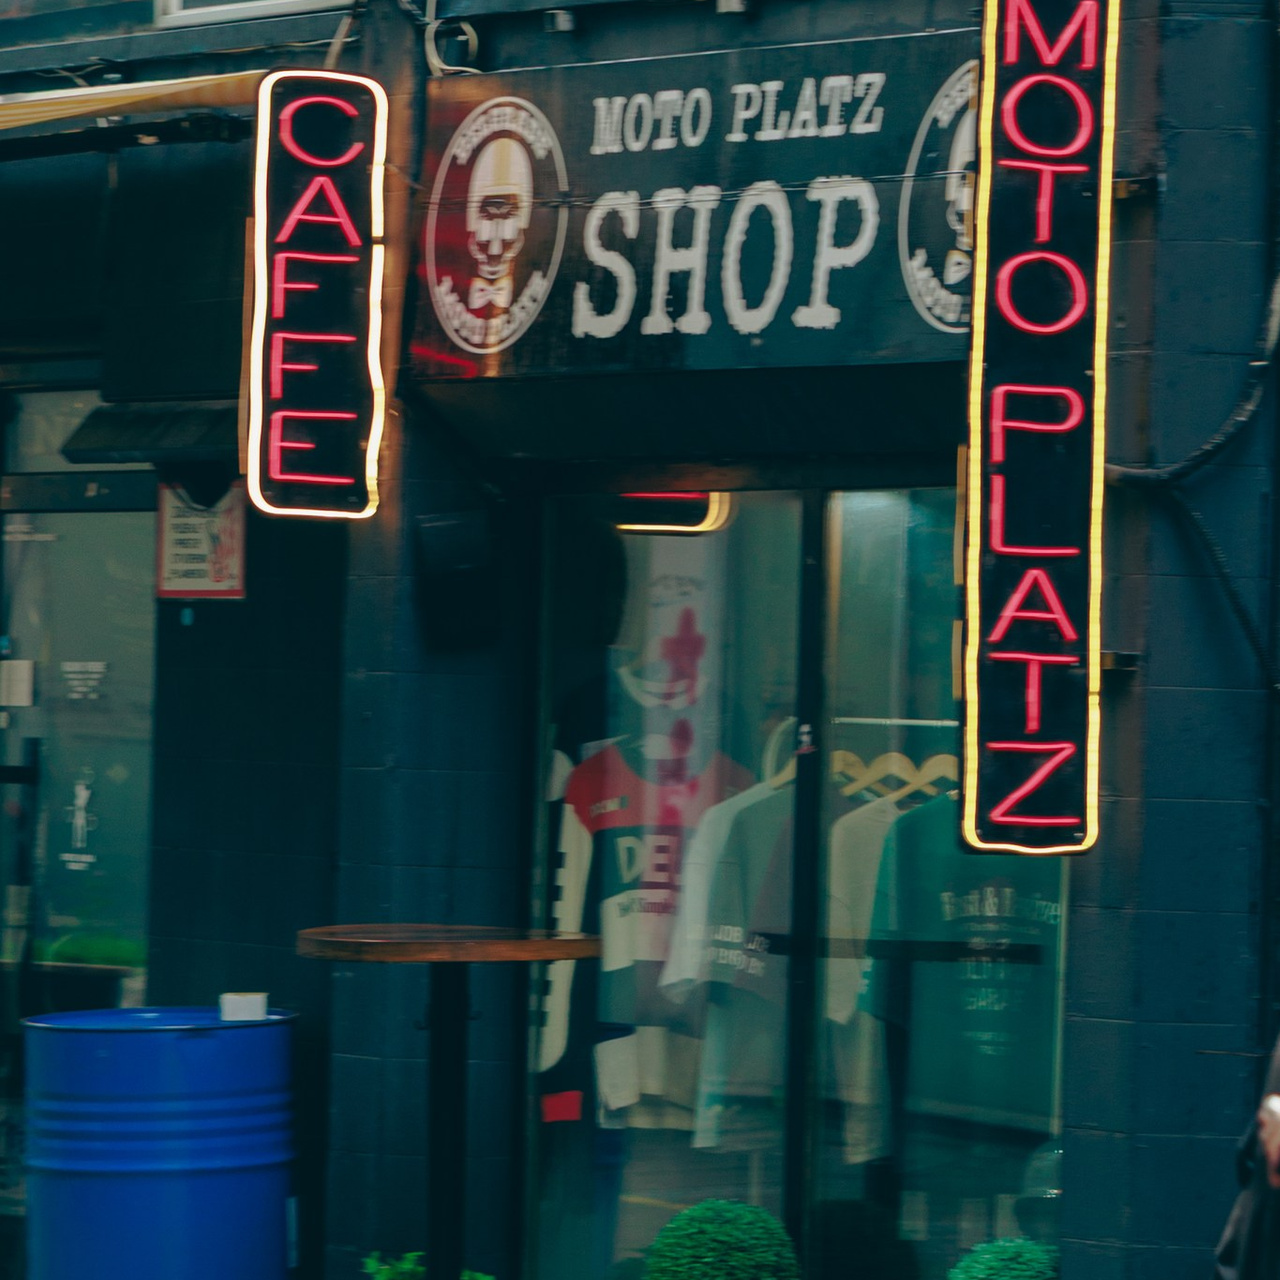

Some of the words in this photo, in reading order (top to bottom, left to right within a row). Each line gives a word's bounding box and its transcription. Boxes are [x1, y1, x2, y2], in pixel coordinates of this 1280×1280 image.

[590, 87, 711, 155] MOTO
[726, 72, 886, 143] PLATZ
[269, 95, 364, 484] CAFFE
[571, 176, 879, 339] SHOP
[986, 384, 1084, 827] PLATZ
